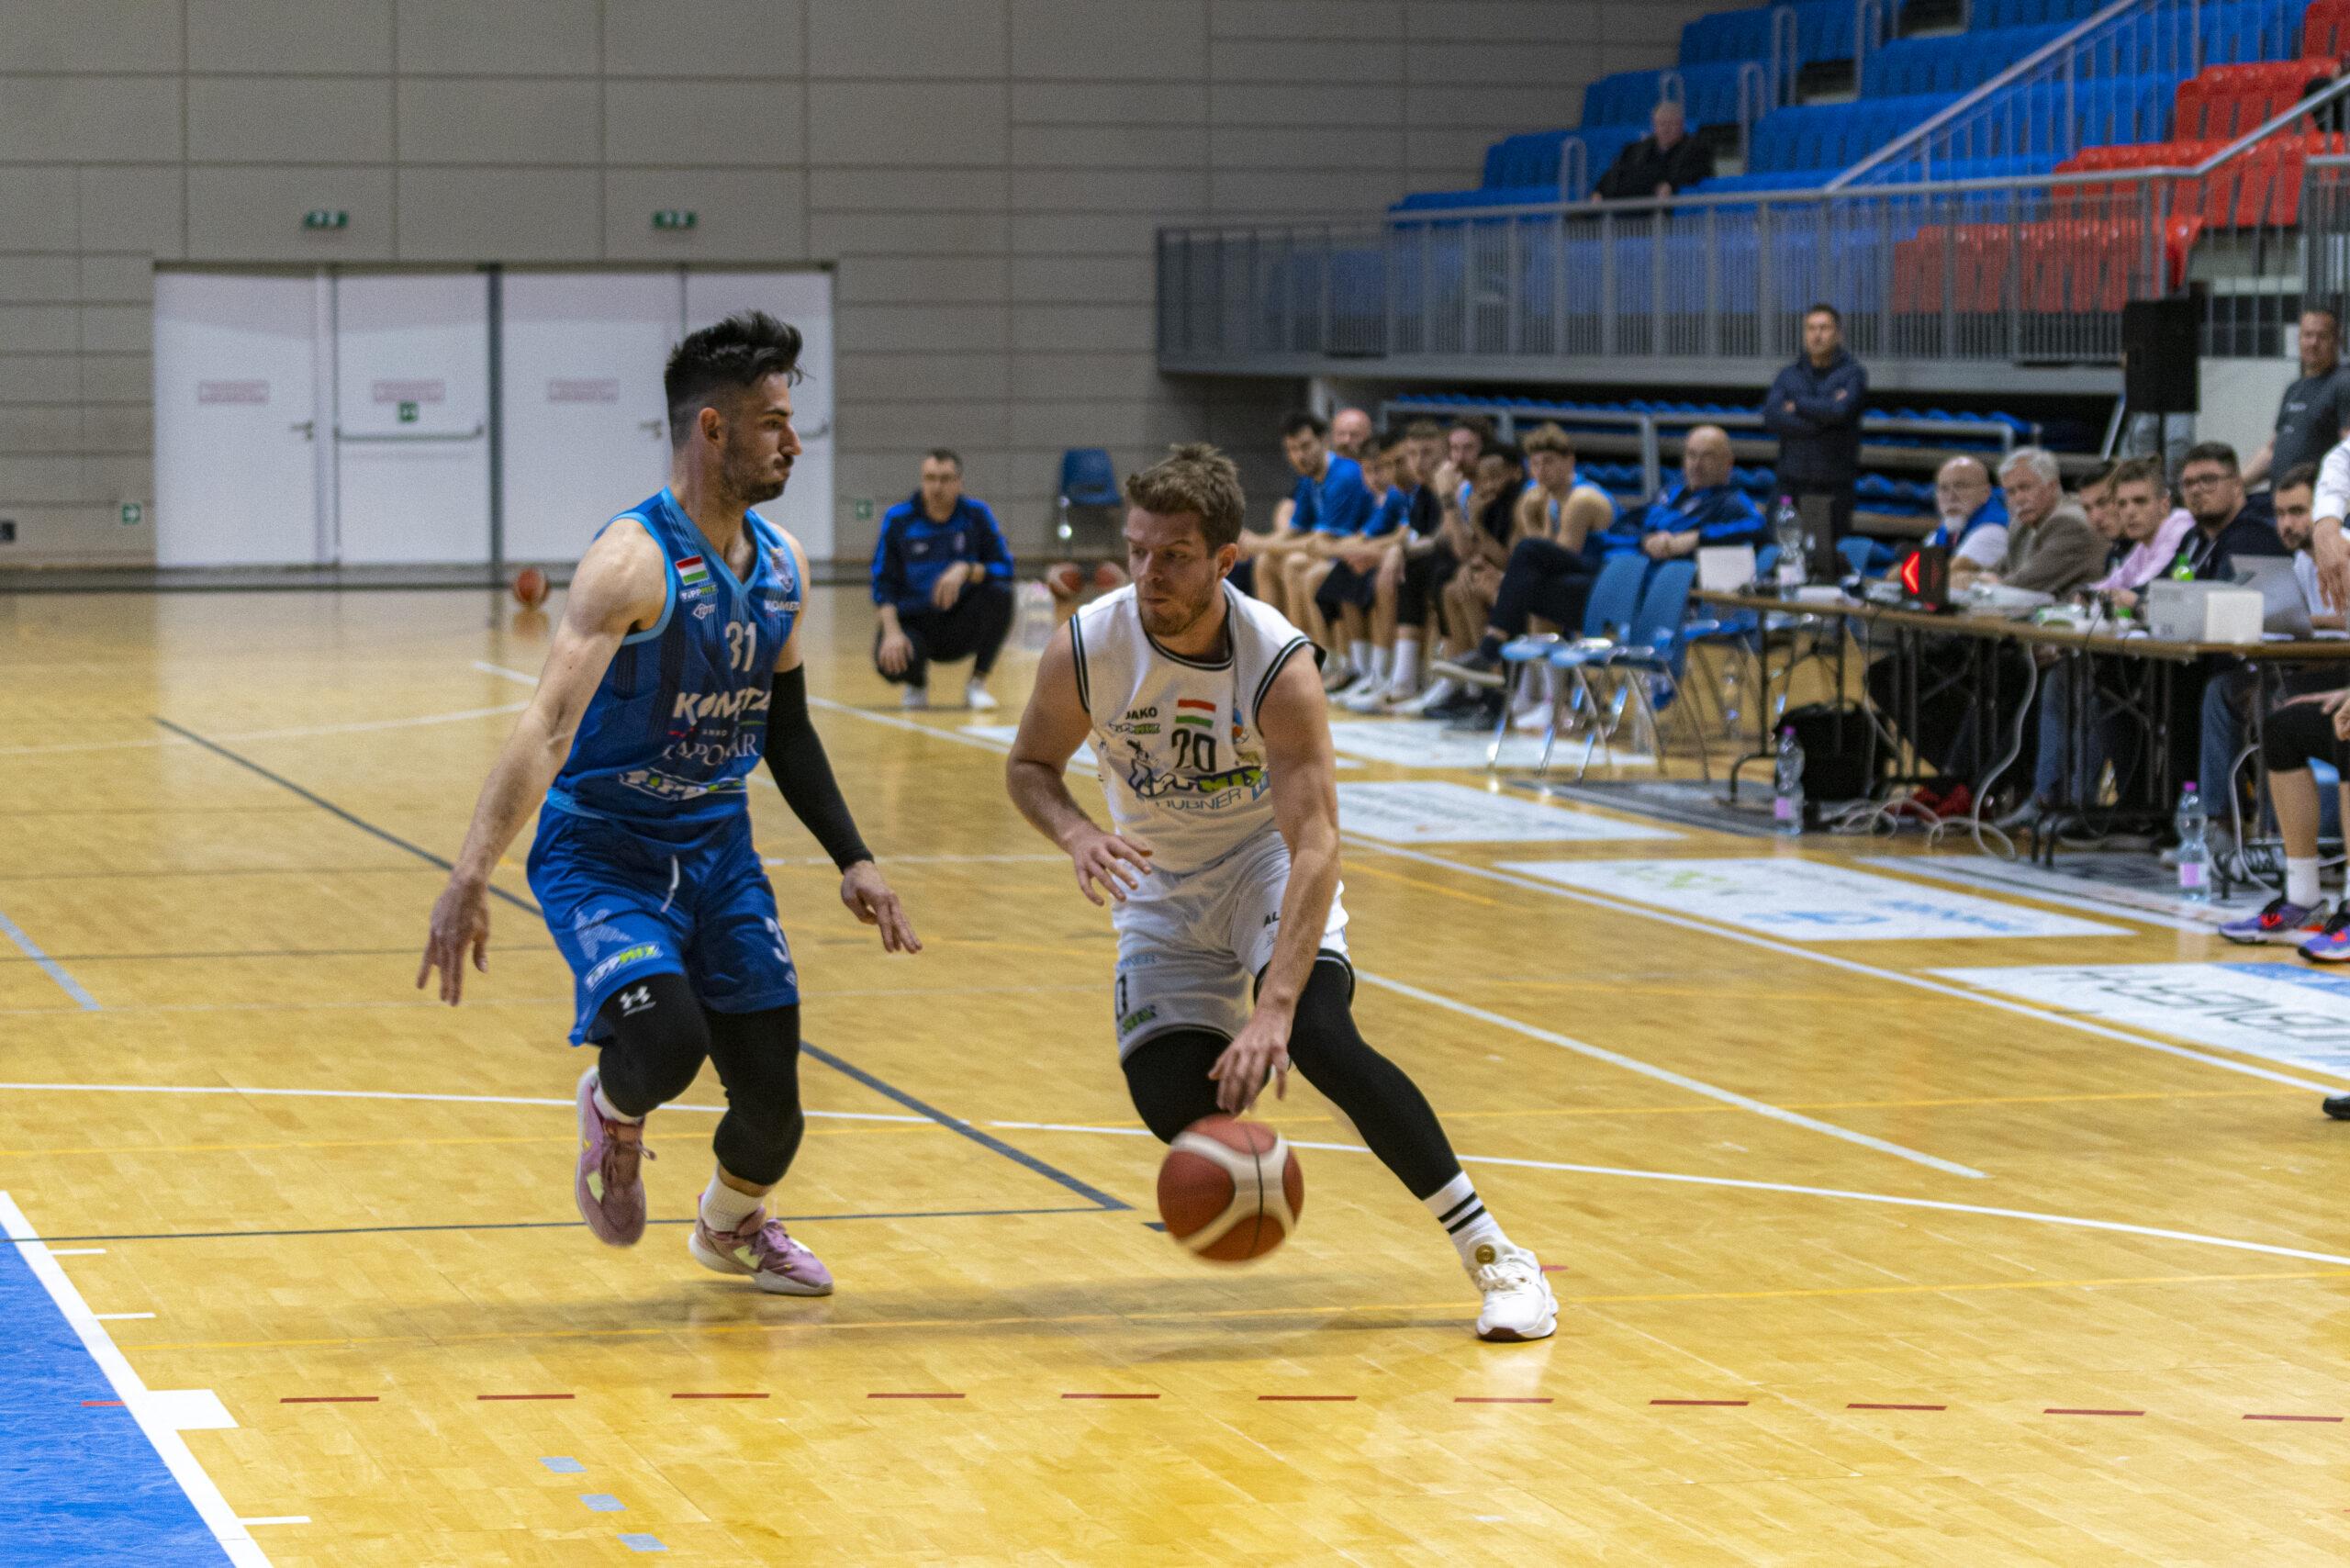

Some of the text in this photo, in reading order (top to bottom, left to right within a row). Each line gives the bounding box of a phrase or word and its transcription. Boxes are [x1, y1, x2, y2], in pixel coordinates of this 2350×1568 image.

[725, 621, 757, 672] 31
[1125, 707, 1158, 720] JAKO
[1171, 728, 1216, 772] 20
